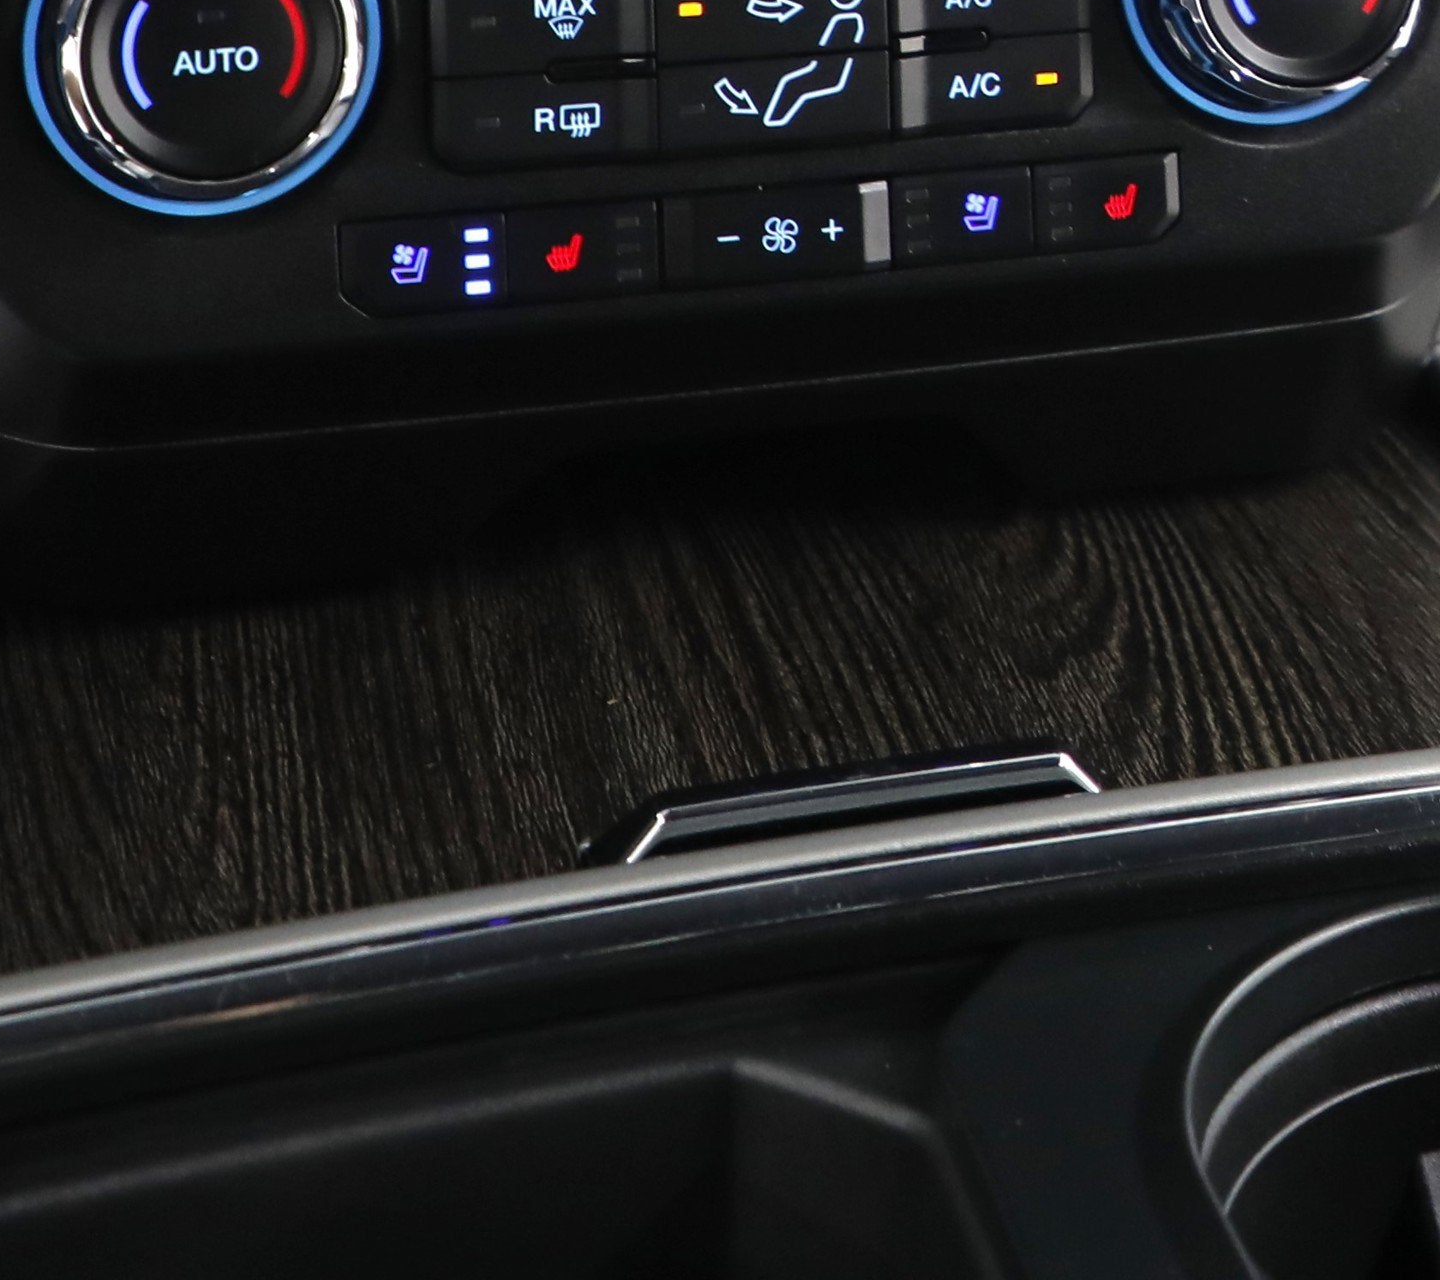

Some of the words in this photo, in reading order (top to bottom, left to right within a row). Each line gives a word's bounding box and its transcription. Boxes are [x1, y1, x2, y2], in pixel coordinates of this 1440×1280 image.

[172, 45, 260, 77] AUTO
[948, 71, 1002, 100] A/C
[534, 107, 556, 133] R
